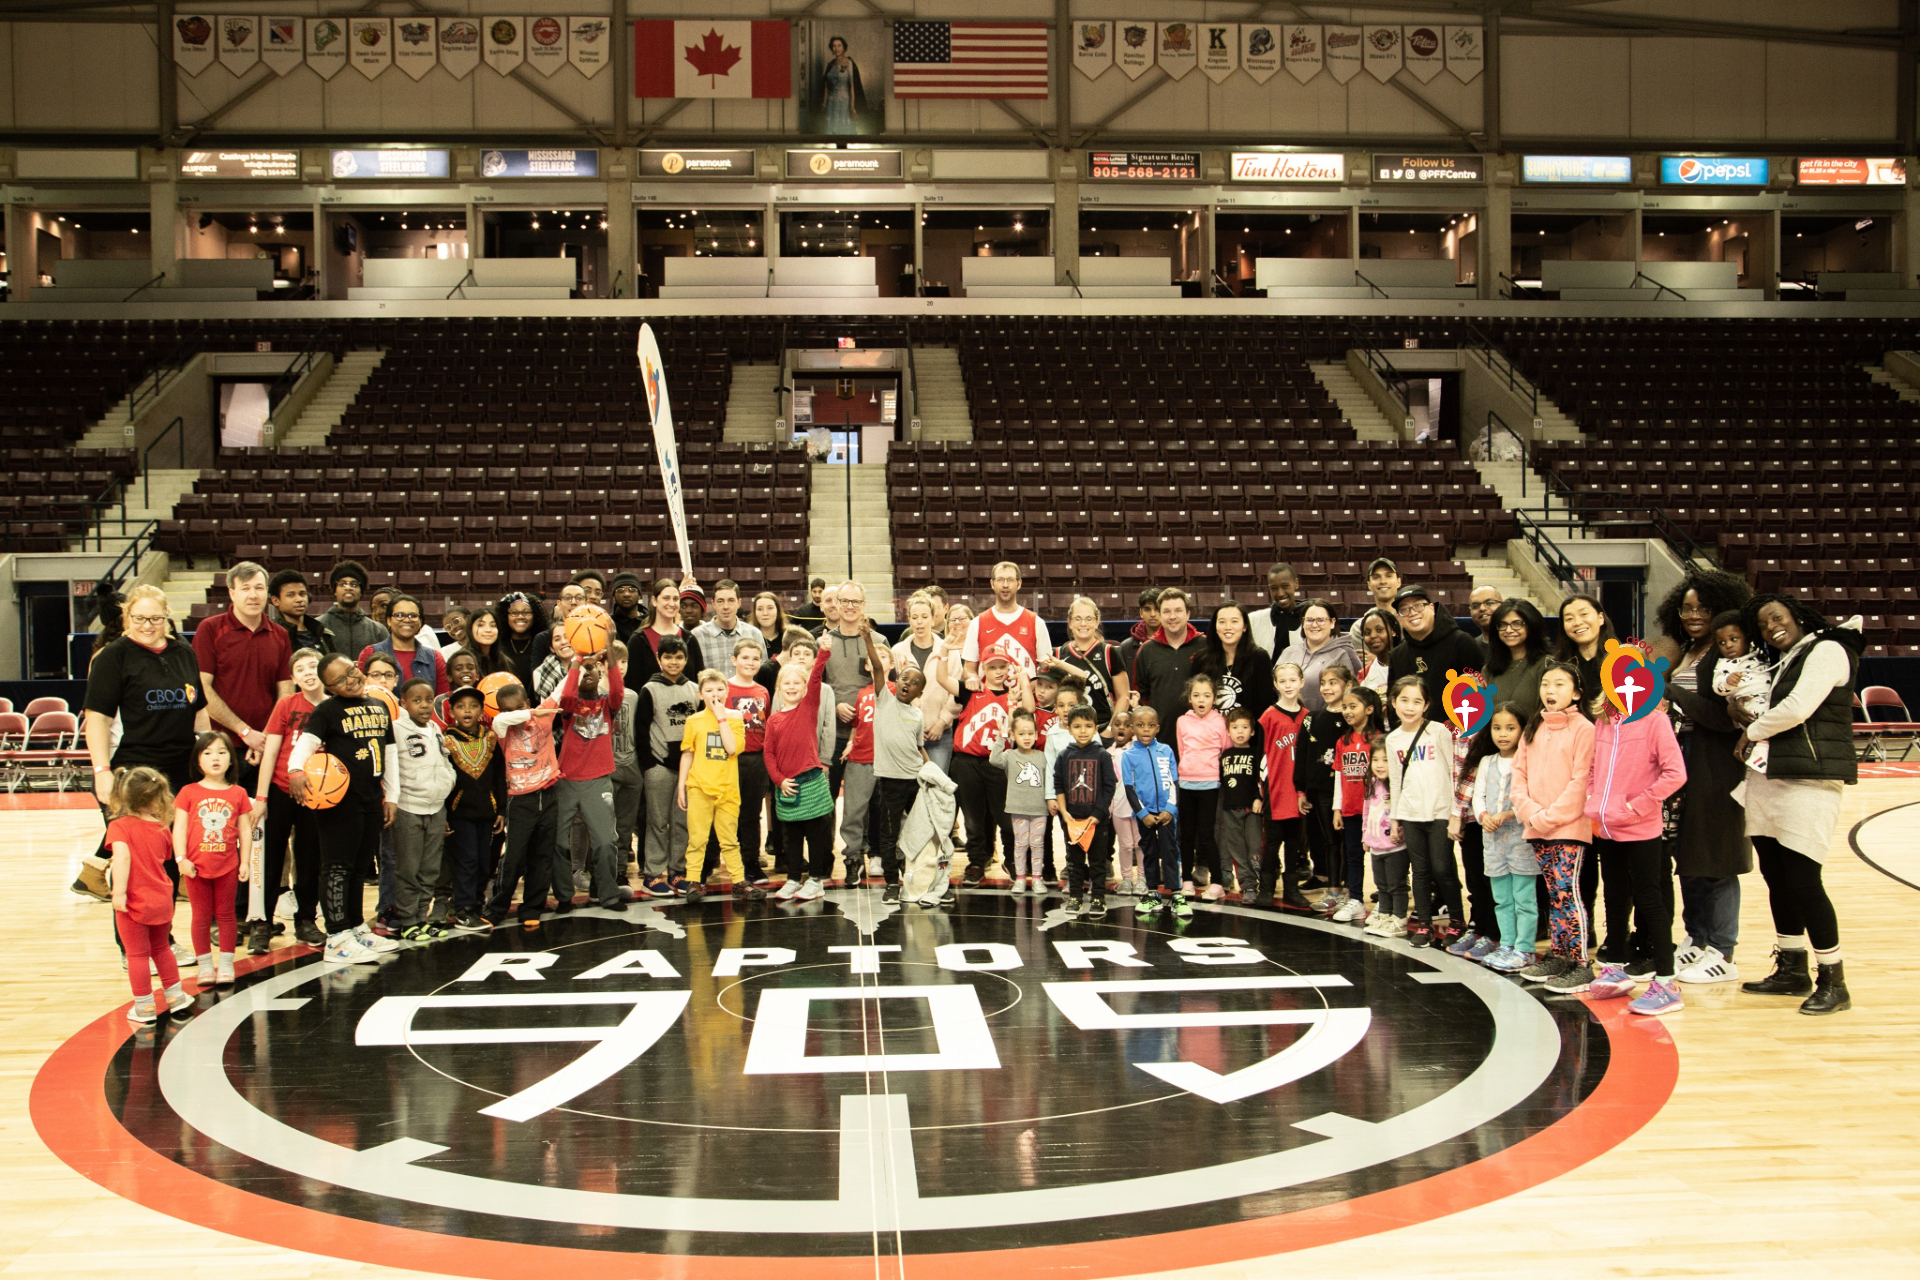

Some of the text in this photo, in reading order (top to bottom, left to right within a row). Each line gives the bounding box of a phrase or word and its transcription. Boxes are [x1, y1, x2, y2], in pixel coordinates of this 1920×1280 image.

[1209, 28, 1227, 50] K
[271, 153, 296, 161] Simple
[378, 150, 427, 161] MISSISSAUGA
[528, 150, 576, 161] MISSISSAUGA
[1131, 153, 1195, 163] Signature Realty
[380, 161, 425, 172] STEELHEADS
[530, 161, 575, 172] STEELHEADS
[667, 157, 678, 169] P
[686, 159, 731, 169] paramount
[815, 158, 826, 170] P
[834, 160, 879, 170] paramount
[1236, 157, 1337, 179] Tim Hortons
[1403, 157, 1455, 167] Follow Us
[1526, 160, 1586, 176] SUNNYSIDE
[1843, 160, 1858, 168] city
[1093, 166, 1196, 178] 905-568-2121
[1418, 169, 1477, 180] @PFFCentre
[1703, 162, 1752, 181] pepsi
[1405, 339, 1418, 348] EXIT
[74, 581, 95, 595] EXIT
[1003, 639, 1030, 668] RTH
[146, 688, 187, 704] CBOQ
[344, 705, 385, 716] WHY TRY
[970, 706, 1006, 733] NORT
[355, 738, 382, 777] #1
[1233, 754, 1254, 765] THE
[1342, 751, 1368, 767] NBA
[1396, 745, 1435, 765] BAVE
[1071, 761, 1094, 776] AIR
[1156, 756, 1171, 791] PUMA
[1071, 776, 1094, 789] JR
[199, 842, 227, 853] 2020
[252, 845, 262, 885] Tangerine
[457, 937, 1267, 981] RAPTORS
[355, 974, 1372, 1123] 905
